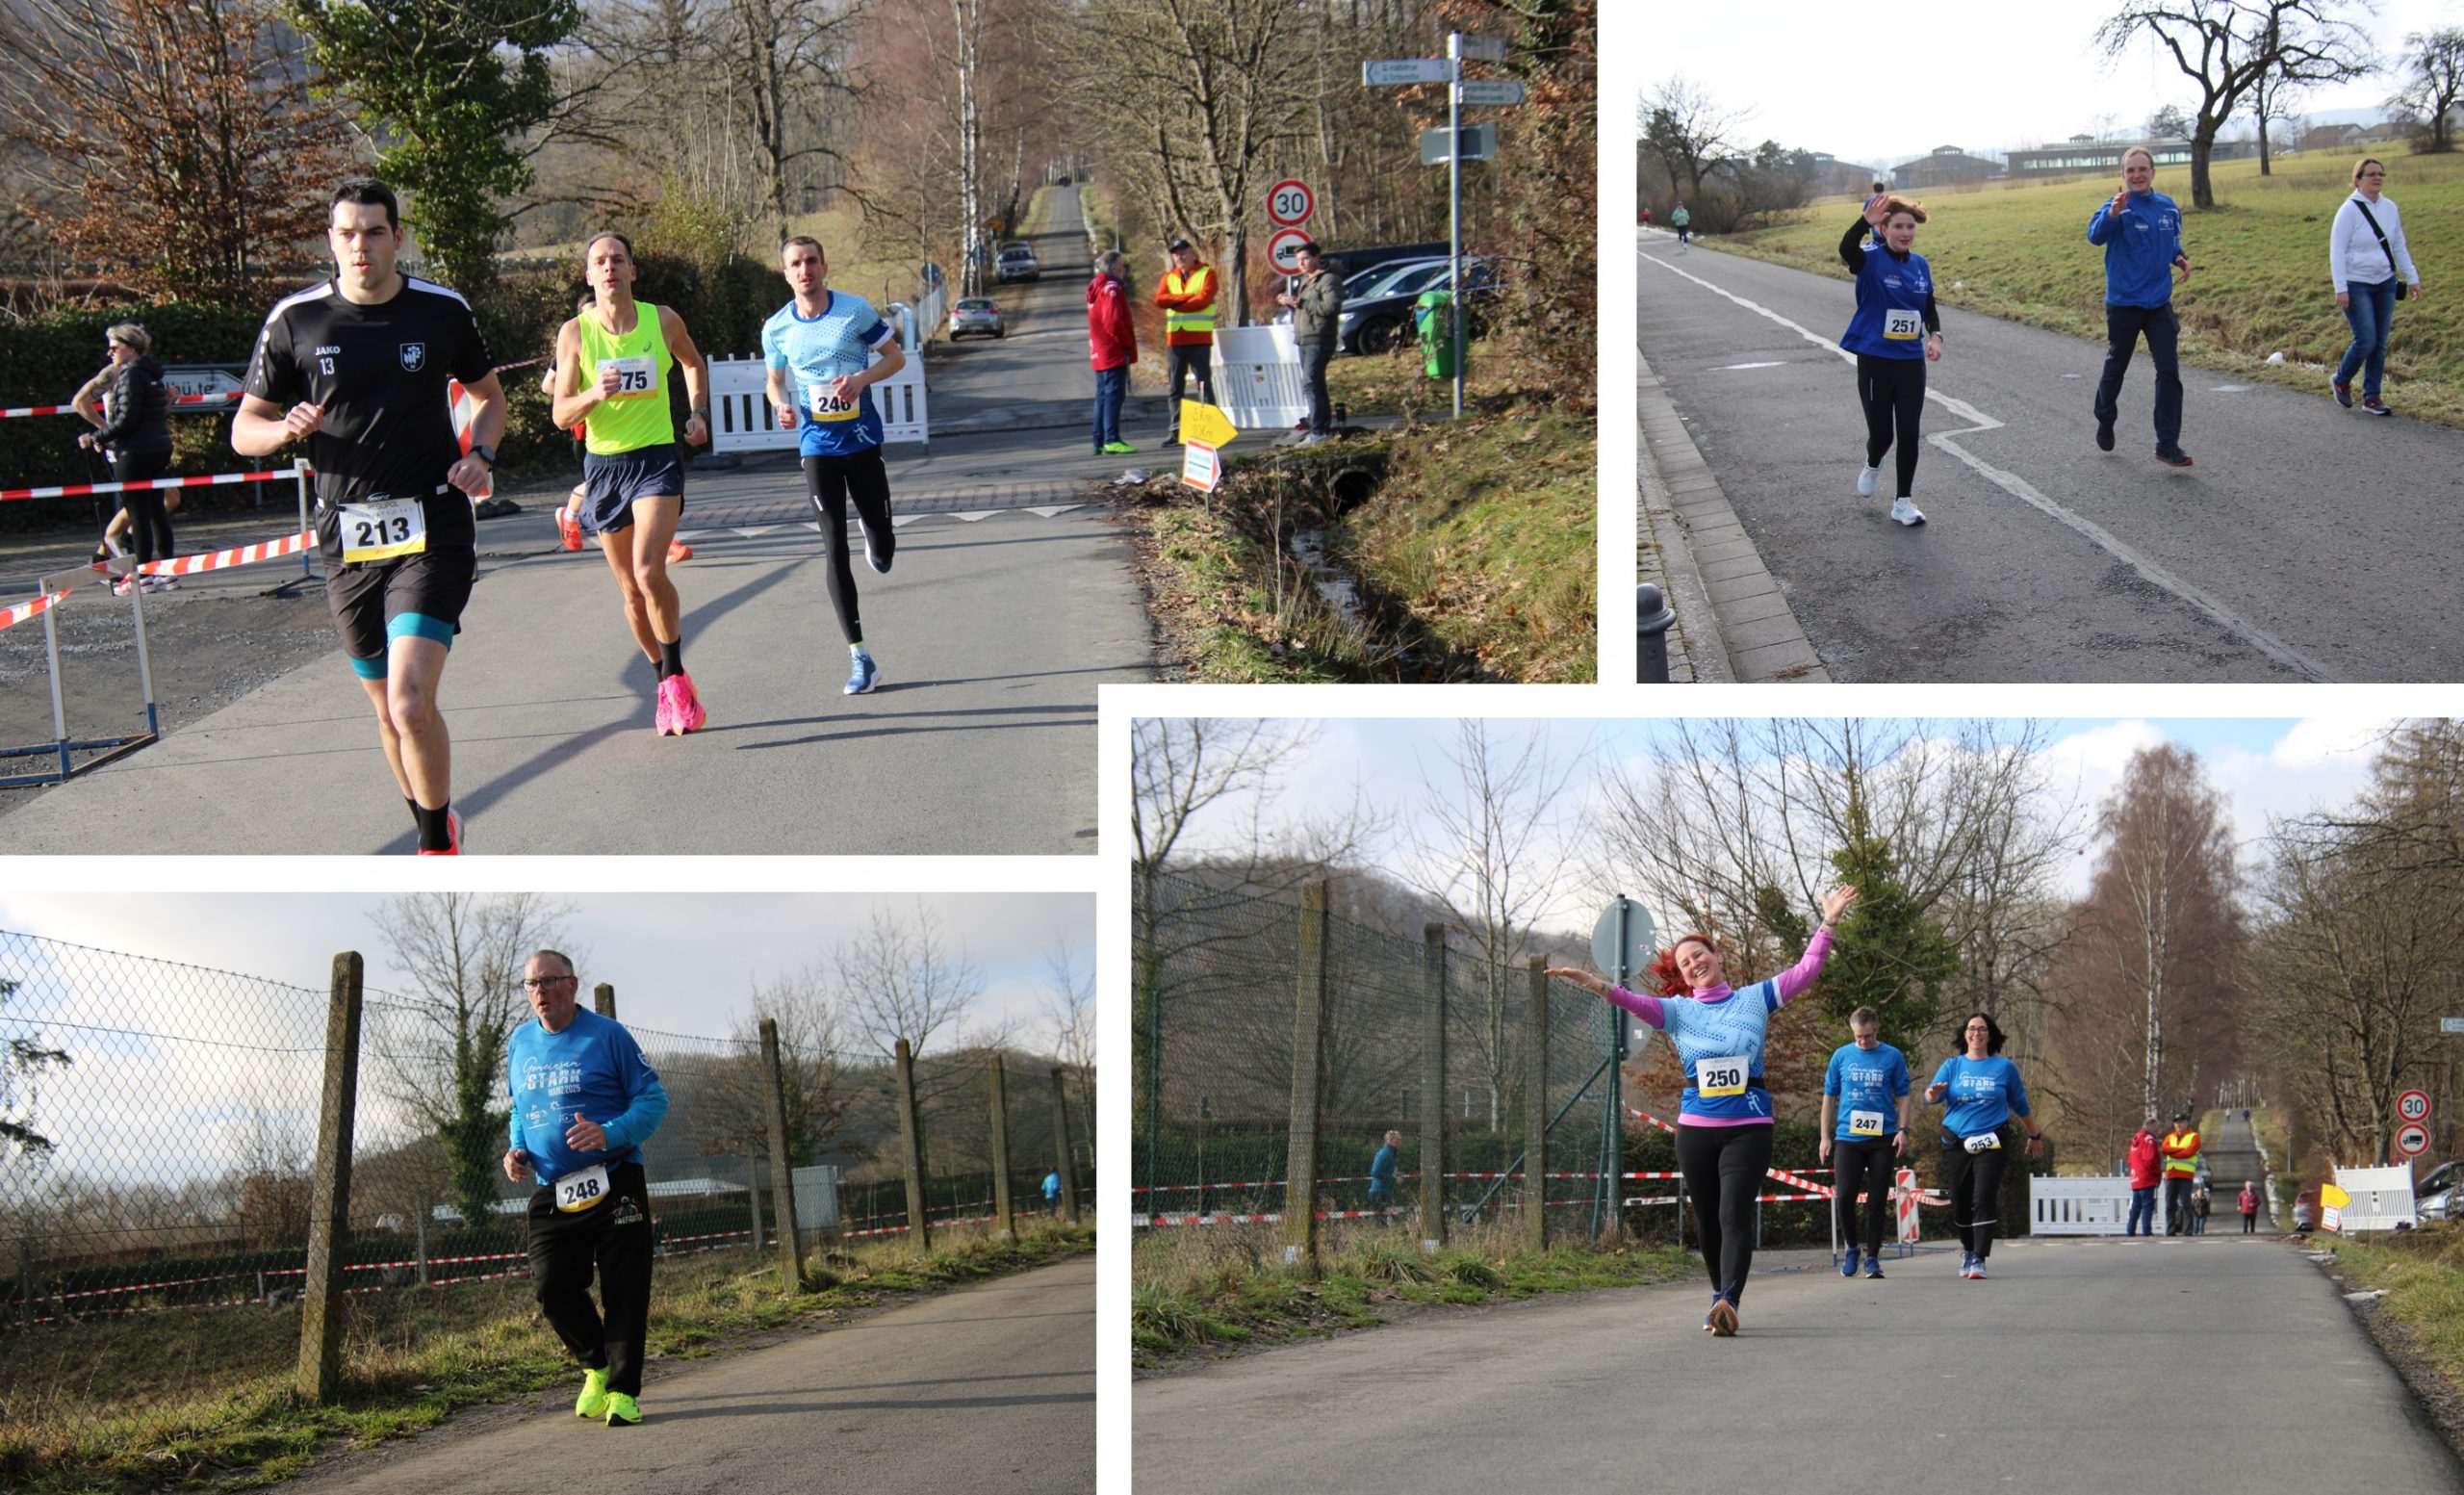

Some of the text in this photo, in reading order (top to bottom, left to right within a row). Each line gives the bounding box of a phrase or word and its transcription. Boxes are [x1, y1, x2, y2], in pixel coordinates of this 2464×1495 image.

[1277, 193, 1304, 215] 30
[1891, 320, 1915, 333] 251
[315, 346, 341, 356] JAKO
[320, 357, 335, 375] 13
[619, 371, 648, 391] 75
[355, 516, 411, 548] 213
[526, 1069, 583, 1091] STARK
[1706, 1069, 1740, 1088] 250
[565, 1084, 581, 1095] 2025
[2403, 1099, 2425, 1114] 30
[1856, 1119, 1878, 1130] 247
[1970, 1136, 1993, 1151] 253
[564, 1178, 601, 1205] 248
